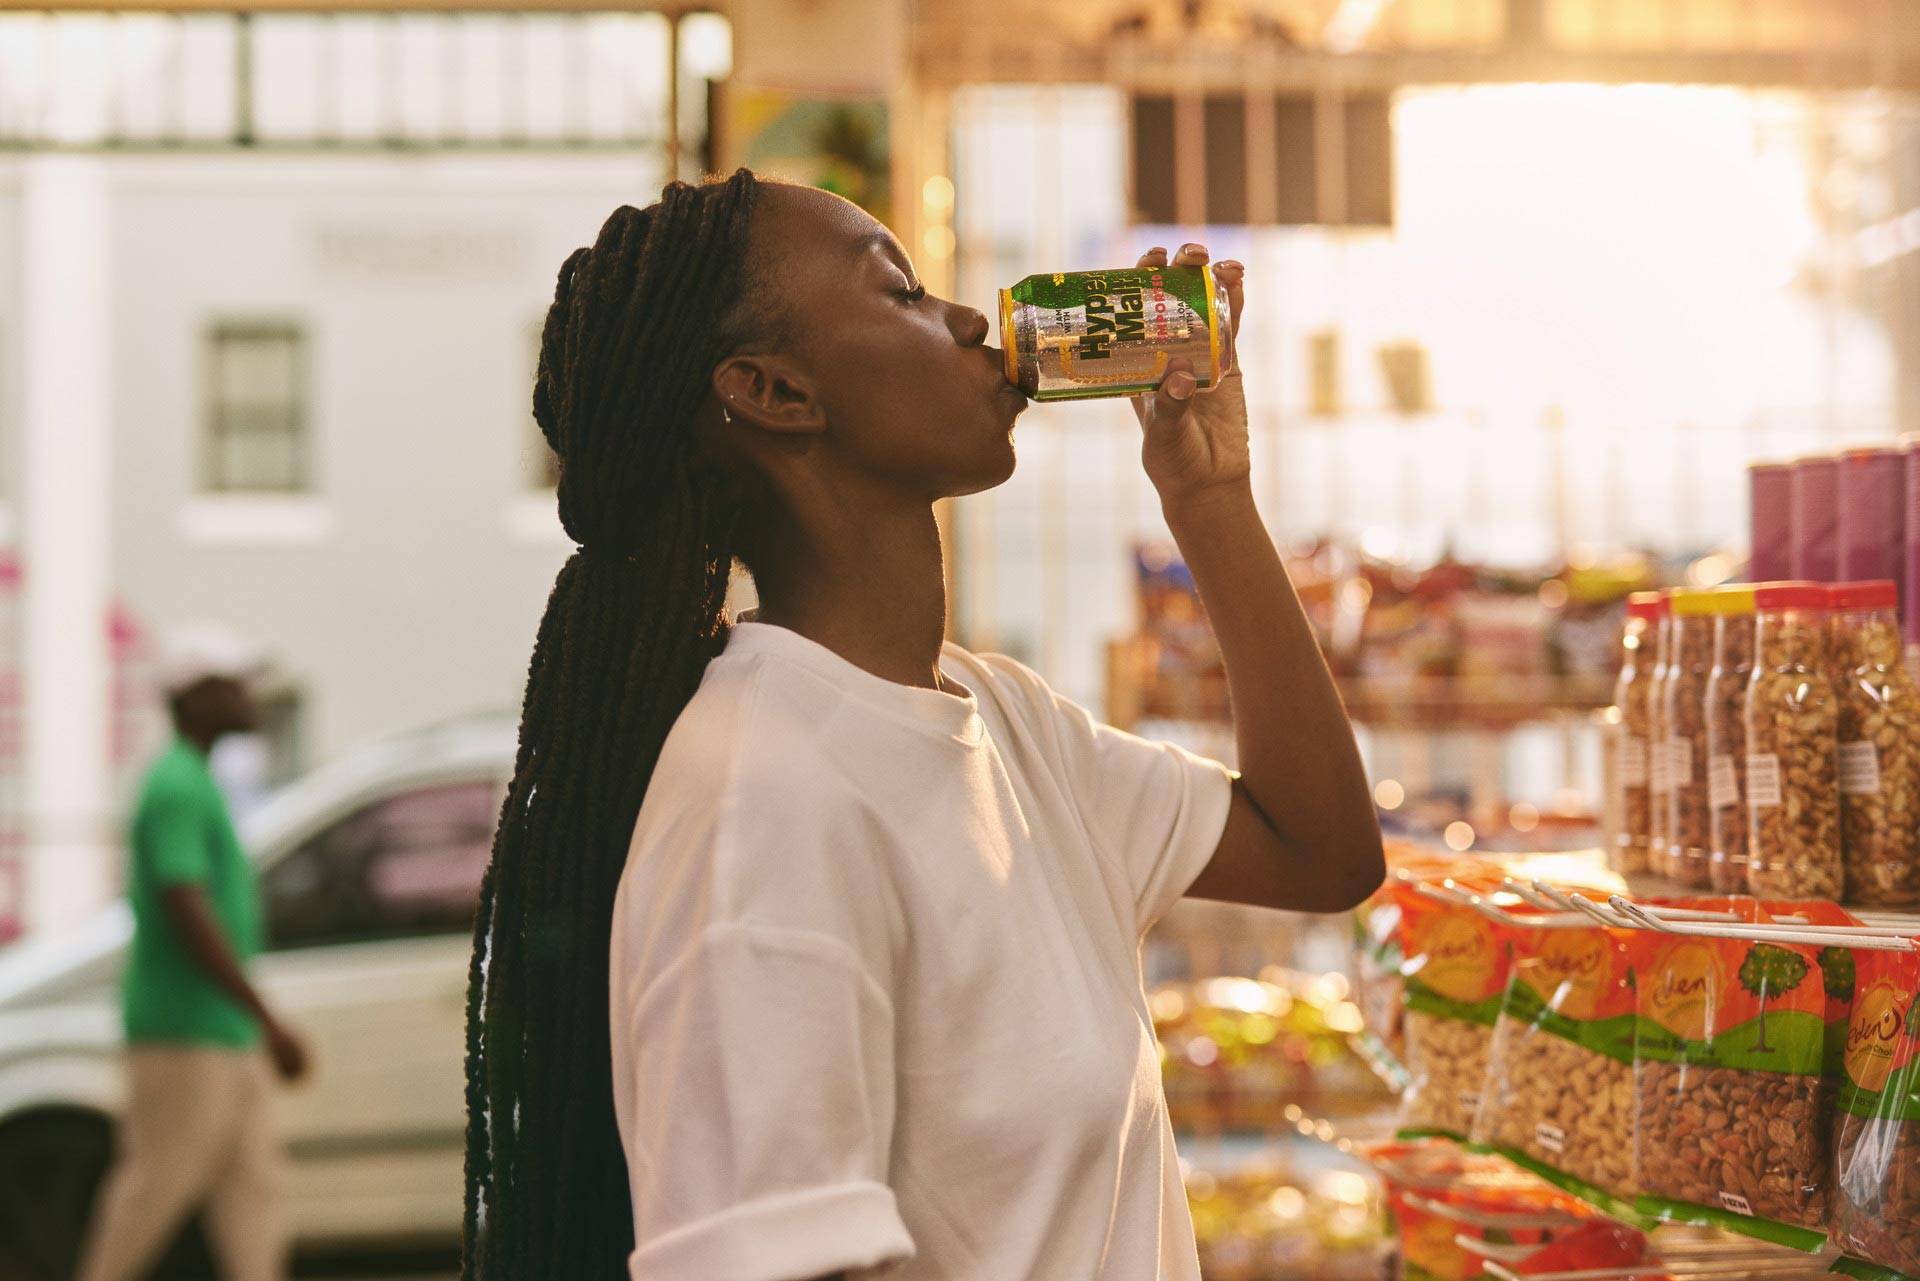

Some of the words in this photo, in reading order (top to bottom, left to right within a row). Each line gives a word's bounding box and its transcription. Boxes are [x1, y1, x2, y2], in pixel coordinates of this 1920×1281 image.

[1079, 273, 1111, 360] Hyper
[1113, 277, 1146, 342] Malt
[1186, 311, 1194, 335] WITH
